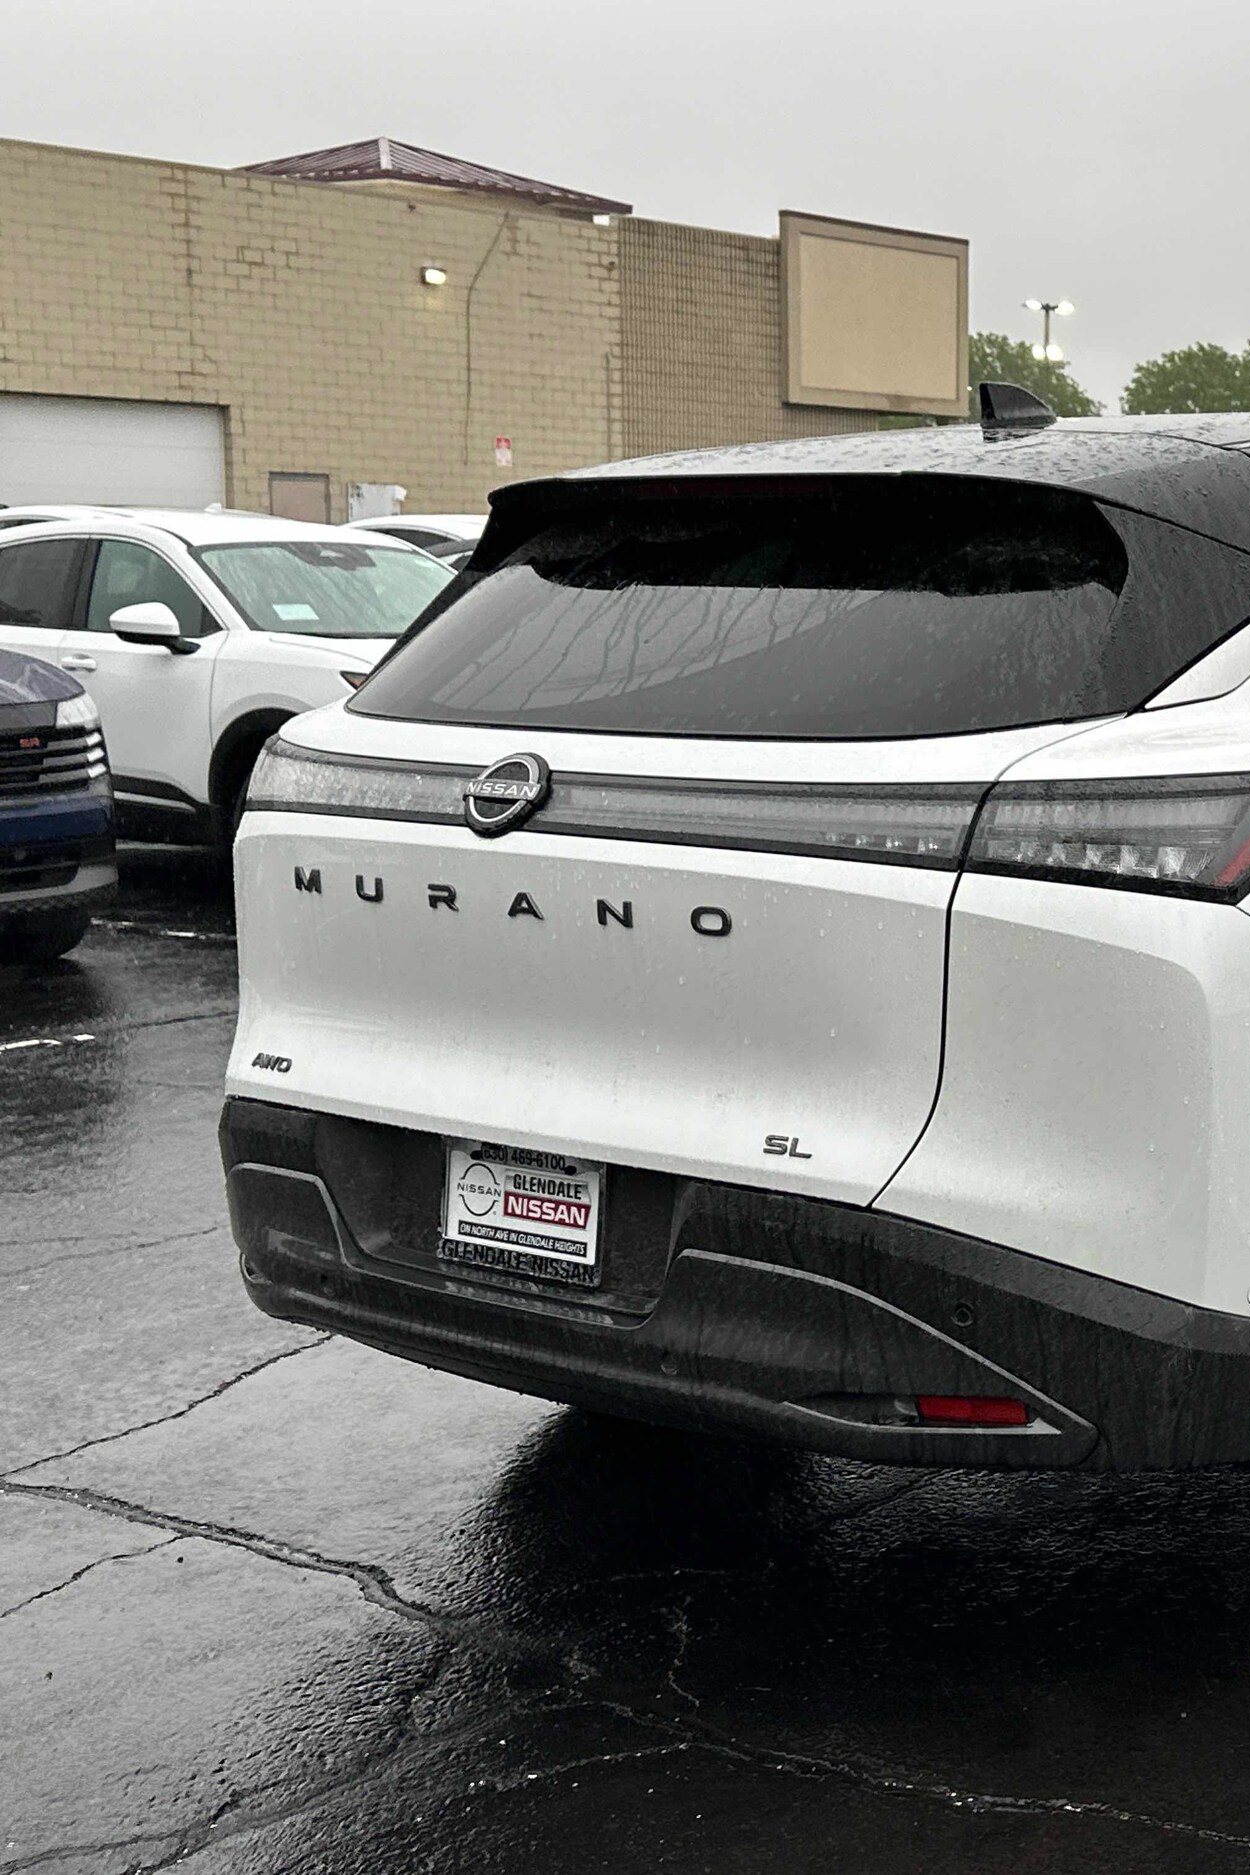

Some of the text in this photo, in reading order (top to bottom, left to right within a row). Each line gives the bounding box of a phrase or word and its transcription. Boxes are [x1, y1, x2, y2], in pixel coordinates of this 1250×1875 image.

[465, 781, 538, 798] NISSAN
[294, 865, 733, 937] MURANO
[251, 1052, 293, 1073] AWD
[762, 1134, 813, 1159] SL
[511, 1149, 566, 1171] 469-6100
[457, 1182, 501, 1198] NISSAN
[513, 1173, 582, 1200] GLENDALE
[507, 1195, 586, 1226] NISSAN
[460, 1222, 585, 1255] ON NORTH AVE IN GLENDALE HEIGHTS
[443, 1239, 595, 1284] GLENDALE NISSAN
